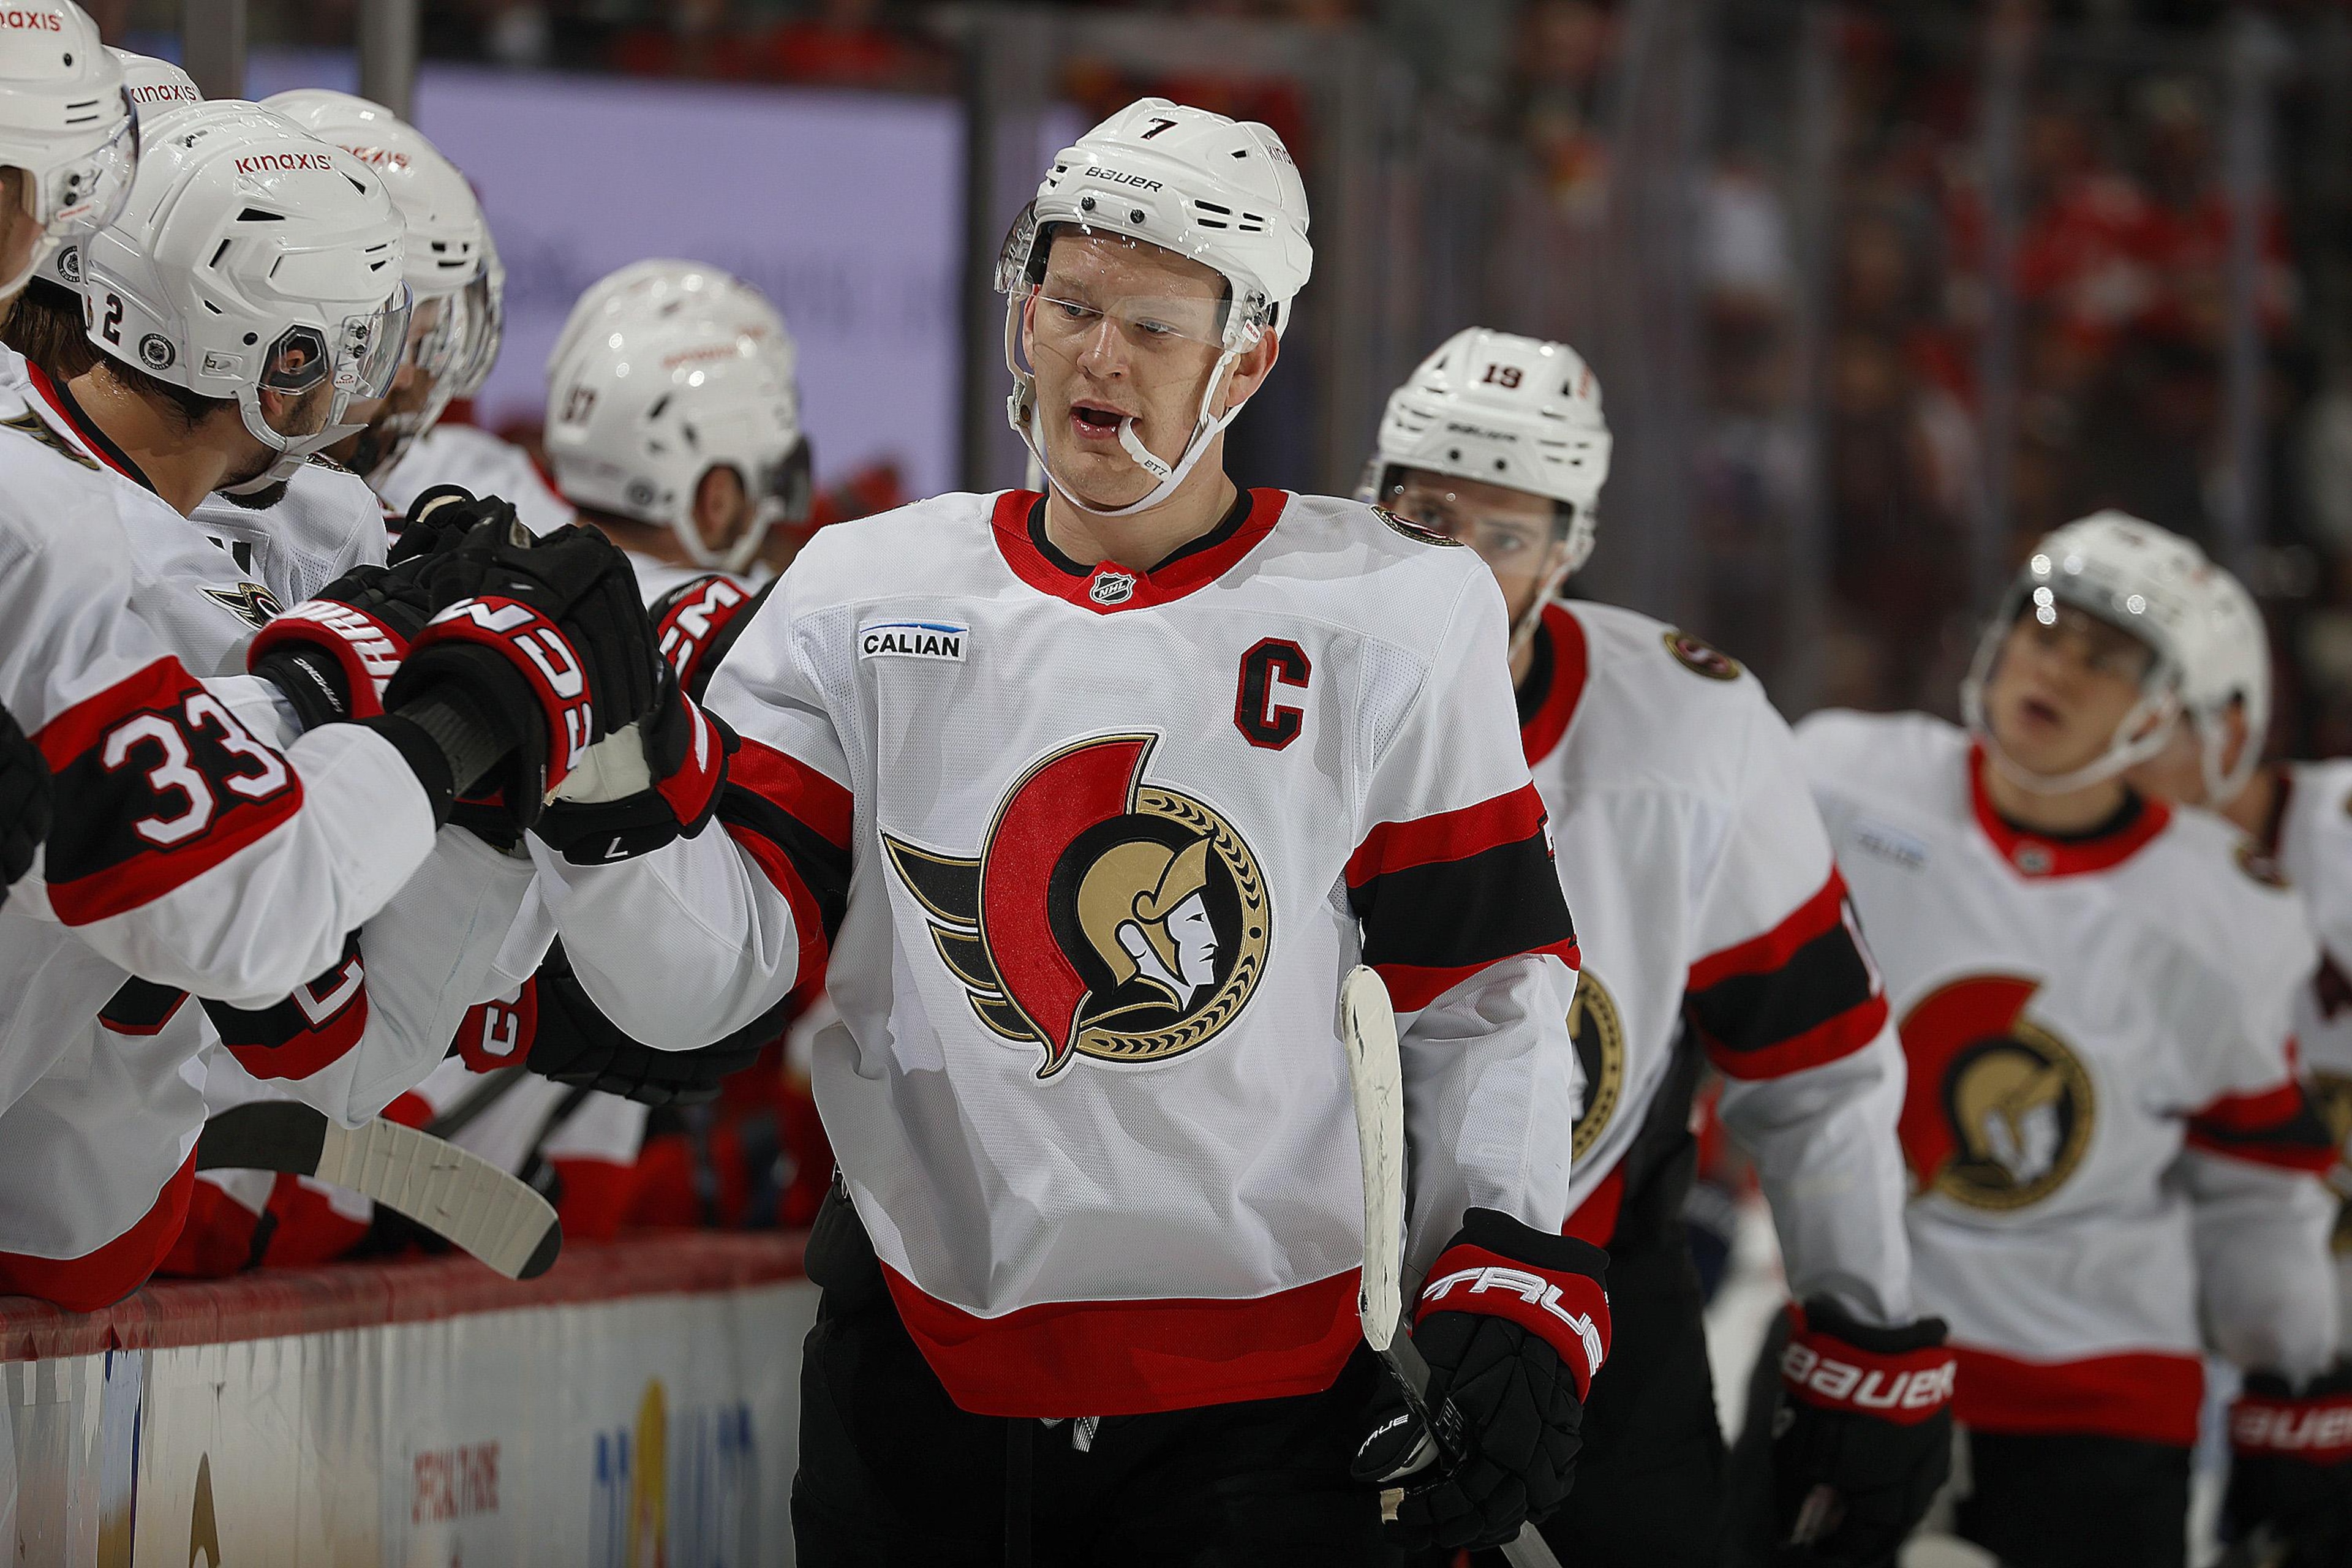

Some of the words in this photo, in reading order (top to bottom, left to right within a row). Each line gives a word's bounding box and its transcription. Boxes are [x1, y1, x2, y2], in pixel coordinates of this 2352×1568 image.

[1140, 118, 1178, 140] 7
[1084, 166, 1163, 193] BAUER
[1482, 363, 1523, 389] 19
[1144, 460, 1167, 476] BT7
[1098, 581, 1126, 598] NHL
[864, 634, 960, 657] CALIAN
[1234, 637, 1312, 751] C
[99, 691, 290, 846] 33
[1422, 1267, 1604, 1378] TRUE
[1357, 1414, 1409, 1458] TRUE
